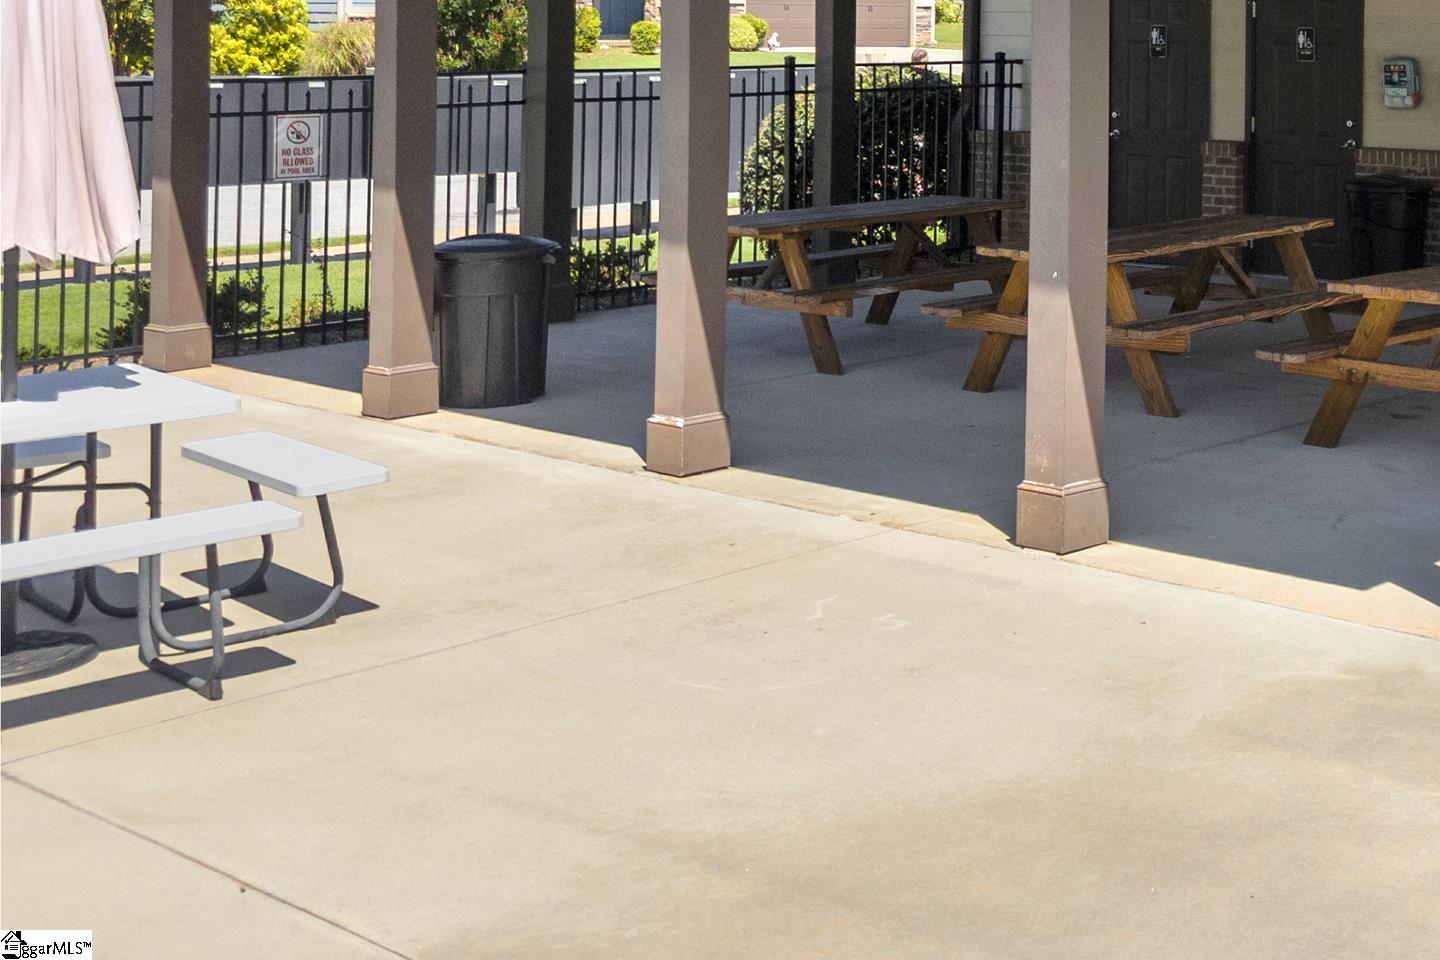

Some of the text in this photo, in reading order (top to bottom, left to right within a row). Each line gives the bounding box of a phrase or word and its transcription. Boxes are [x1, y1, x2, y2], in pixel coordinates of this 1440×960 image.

[281, 147, 314, 157] NO GLASS
[282, 157, 314, 166] ALLOWED
[287, 167, 301, 175] POOL
